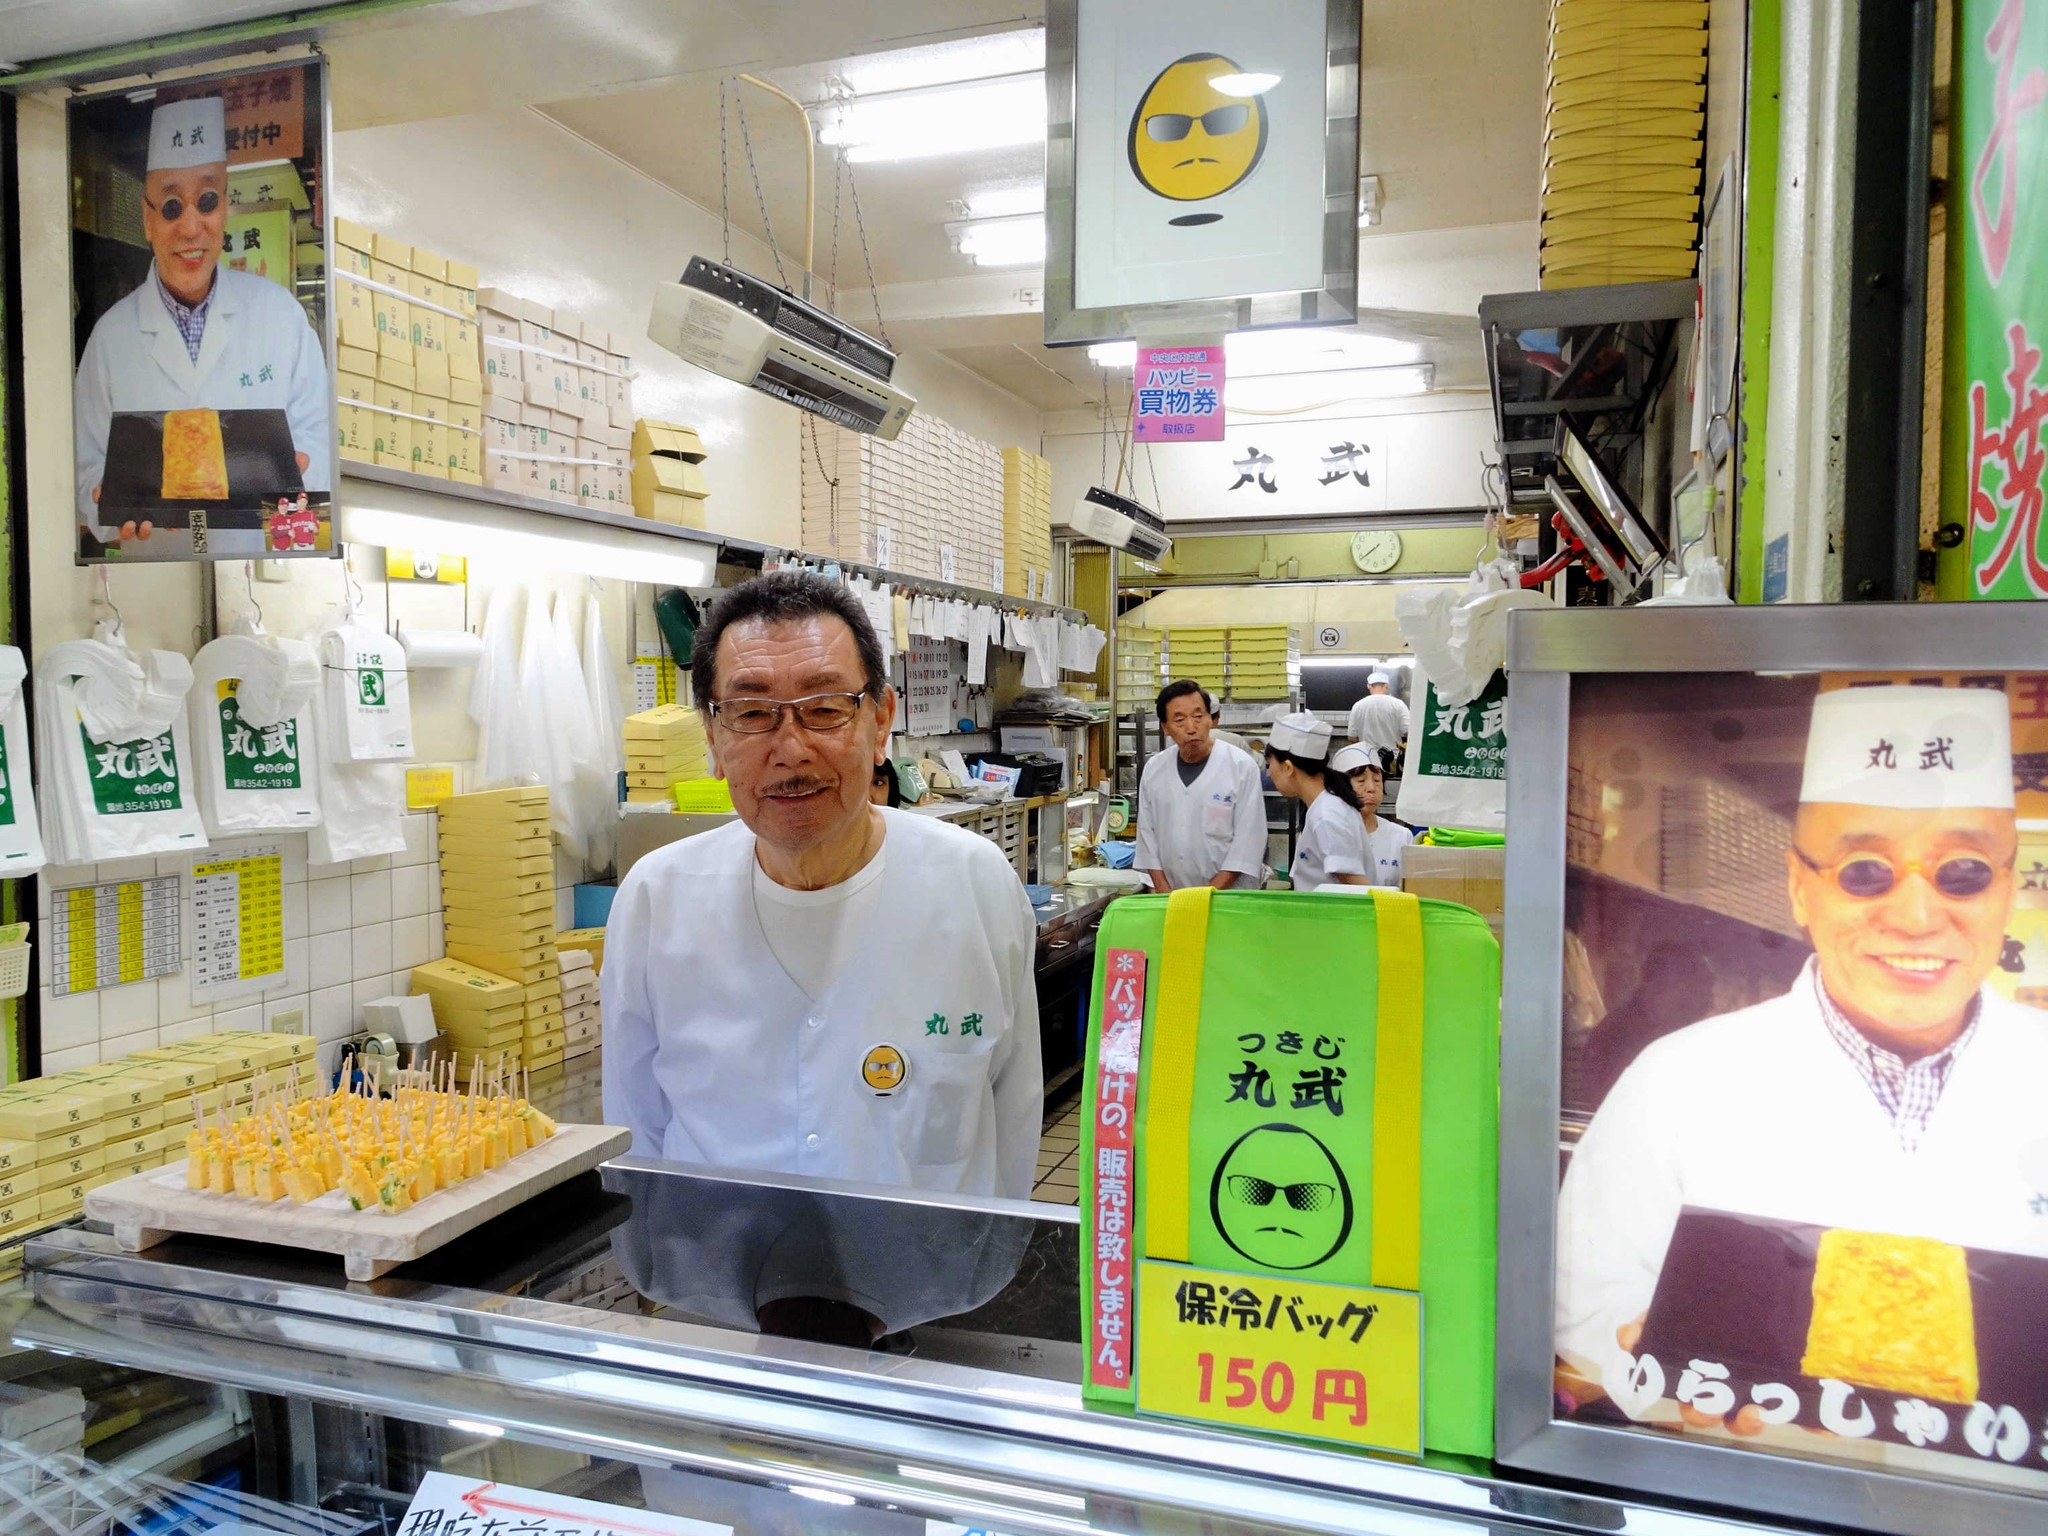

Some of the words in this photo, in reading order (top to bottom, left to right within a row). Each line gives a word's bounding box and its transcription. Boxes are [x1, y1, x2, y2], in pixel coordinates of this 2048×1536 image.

[171, 126, 204, 149] 丸武
[240, 365, 273, 388] 丸武
[1148, 367, 1212, 386] ハッピー
[1139, 388, 1217, 415] 買物券
[1162, 423, 1196, 435] 取扱店
[1227, 441, 1371, 493] 丸武
[226, 721, 297, 760] 丸武
[1866, 736, 1955, 771] 丸武
[95, 736, 176, 779] 丸武
[1430, 763, 1505, 777] 築地3542-1919
[924, 1011, 983, 1037] 丸武
[1236, 1030, 1345, 1061] つきじ
[1224, 1062, 1348, 1117] 丸武
[1174, 1279, 1380, 1345] 保冷バッグ
[1616, 1350, 2048, 1463] いらっしゃい
